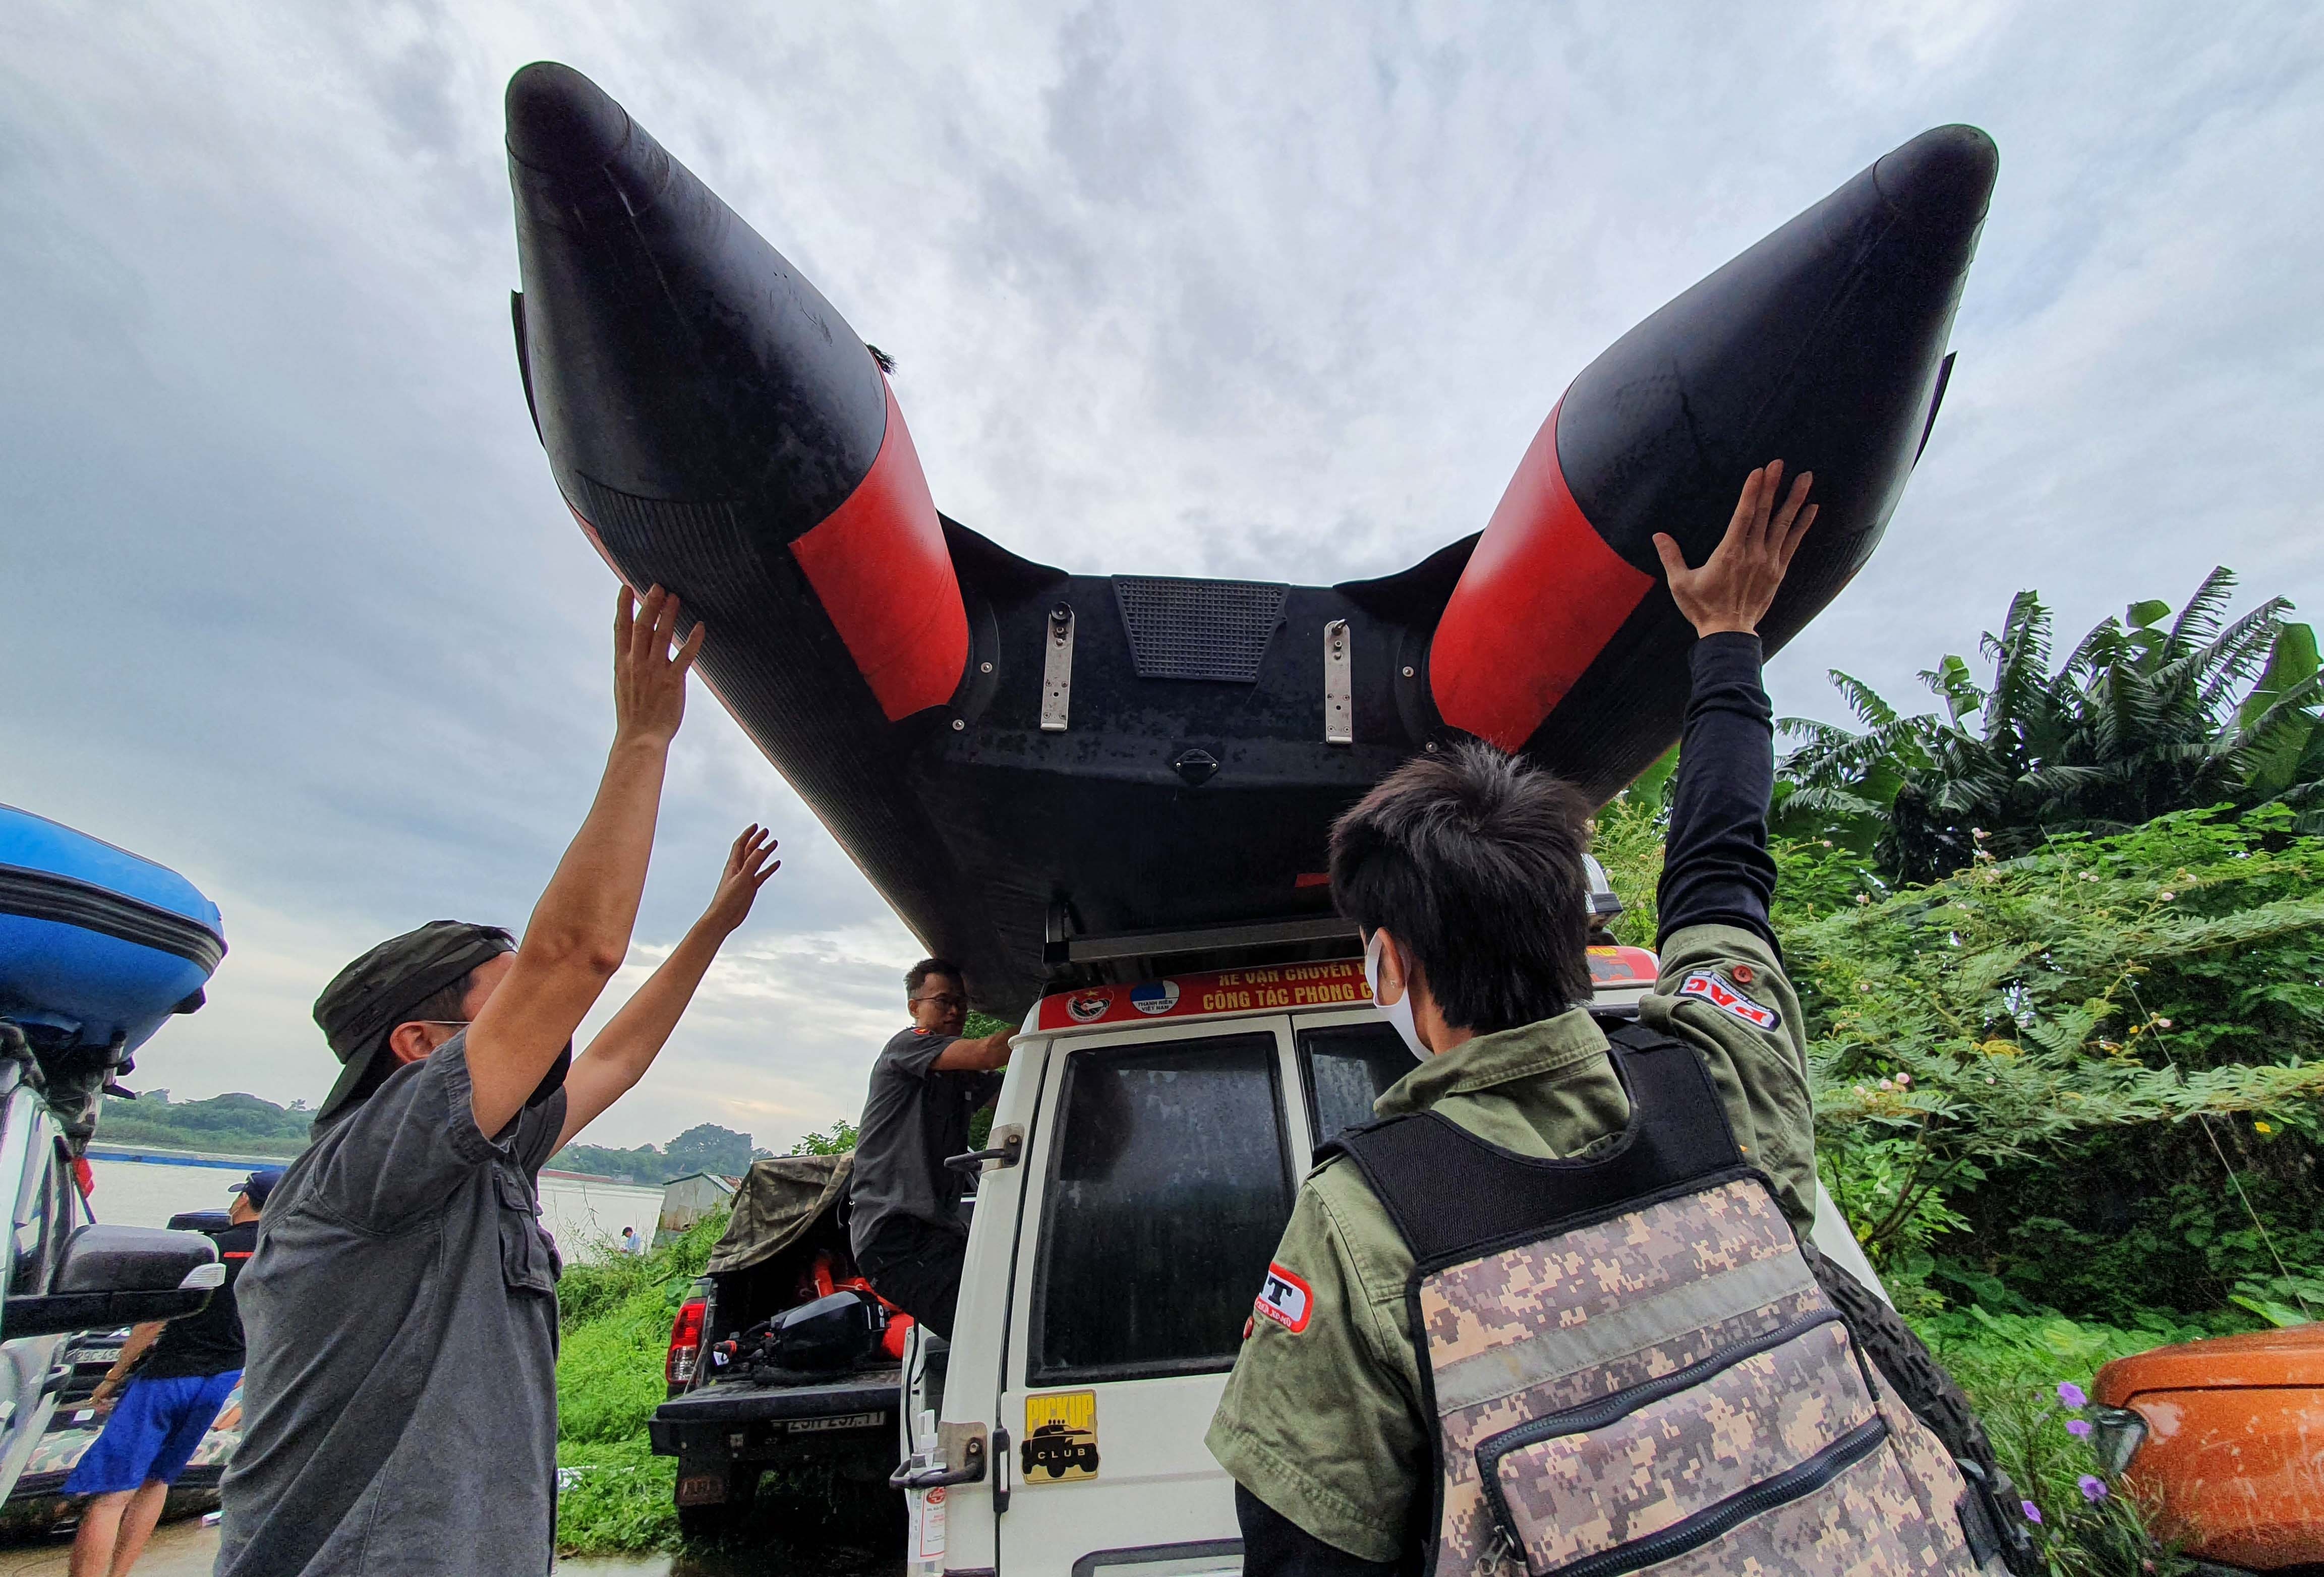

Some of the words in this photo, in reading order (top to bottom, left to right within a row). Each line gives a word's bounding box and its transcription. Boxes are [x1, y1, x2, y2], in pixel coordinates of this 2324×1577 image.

[1203, 990, 1250, 1010] CÔNG
[1255, 986, 1289, 1006] TÁC
[1295, 982, 1355, 1004] PHÒNG
[1027, 1394, 1094, 1432] PICKUP
[1037, 1448, 1085, 1459] CLUB
